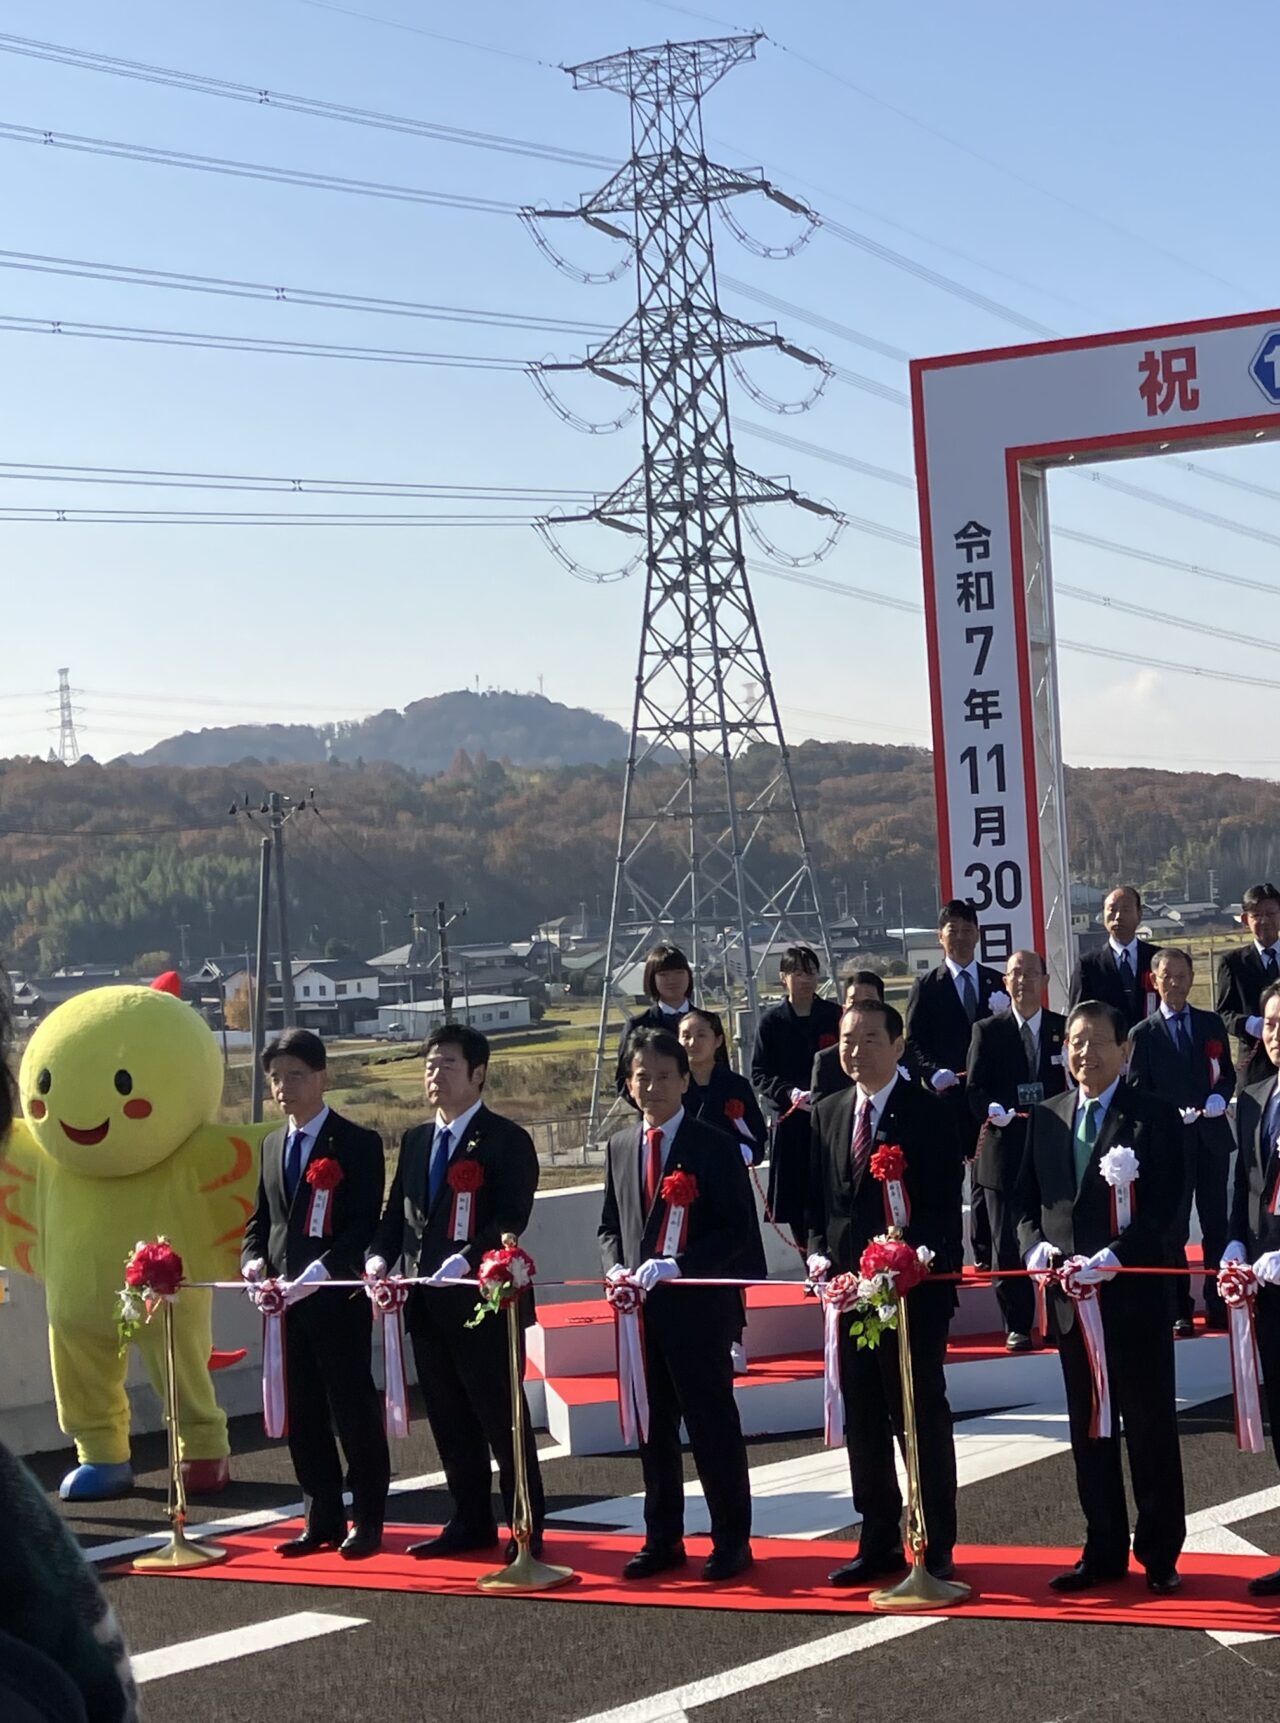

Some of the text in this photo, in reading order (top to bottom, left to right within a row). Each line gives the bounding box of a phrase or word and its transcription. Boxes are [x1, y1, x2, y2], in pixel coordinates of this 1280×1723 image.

[1138, 346, 1200, 416] 祝
[953, 520, 1023, 963] 令和7年11月30日
